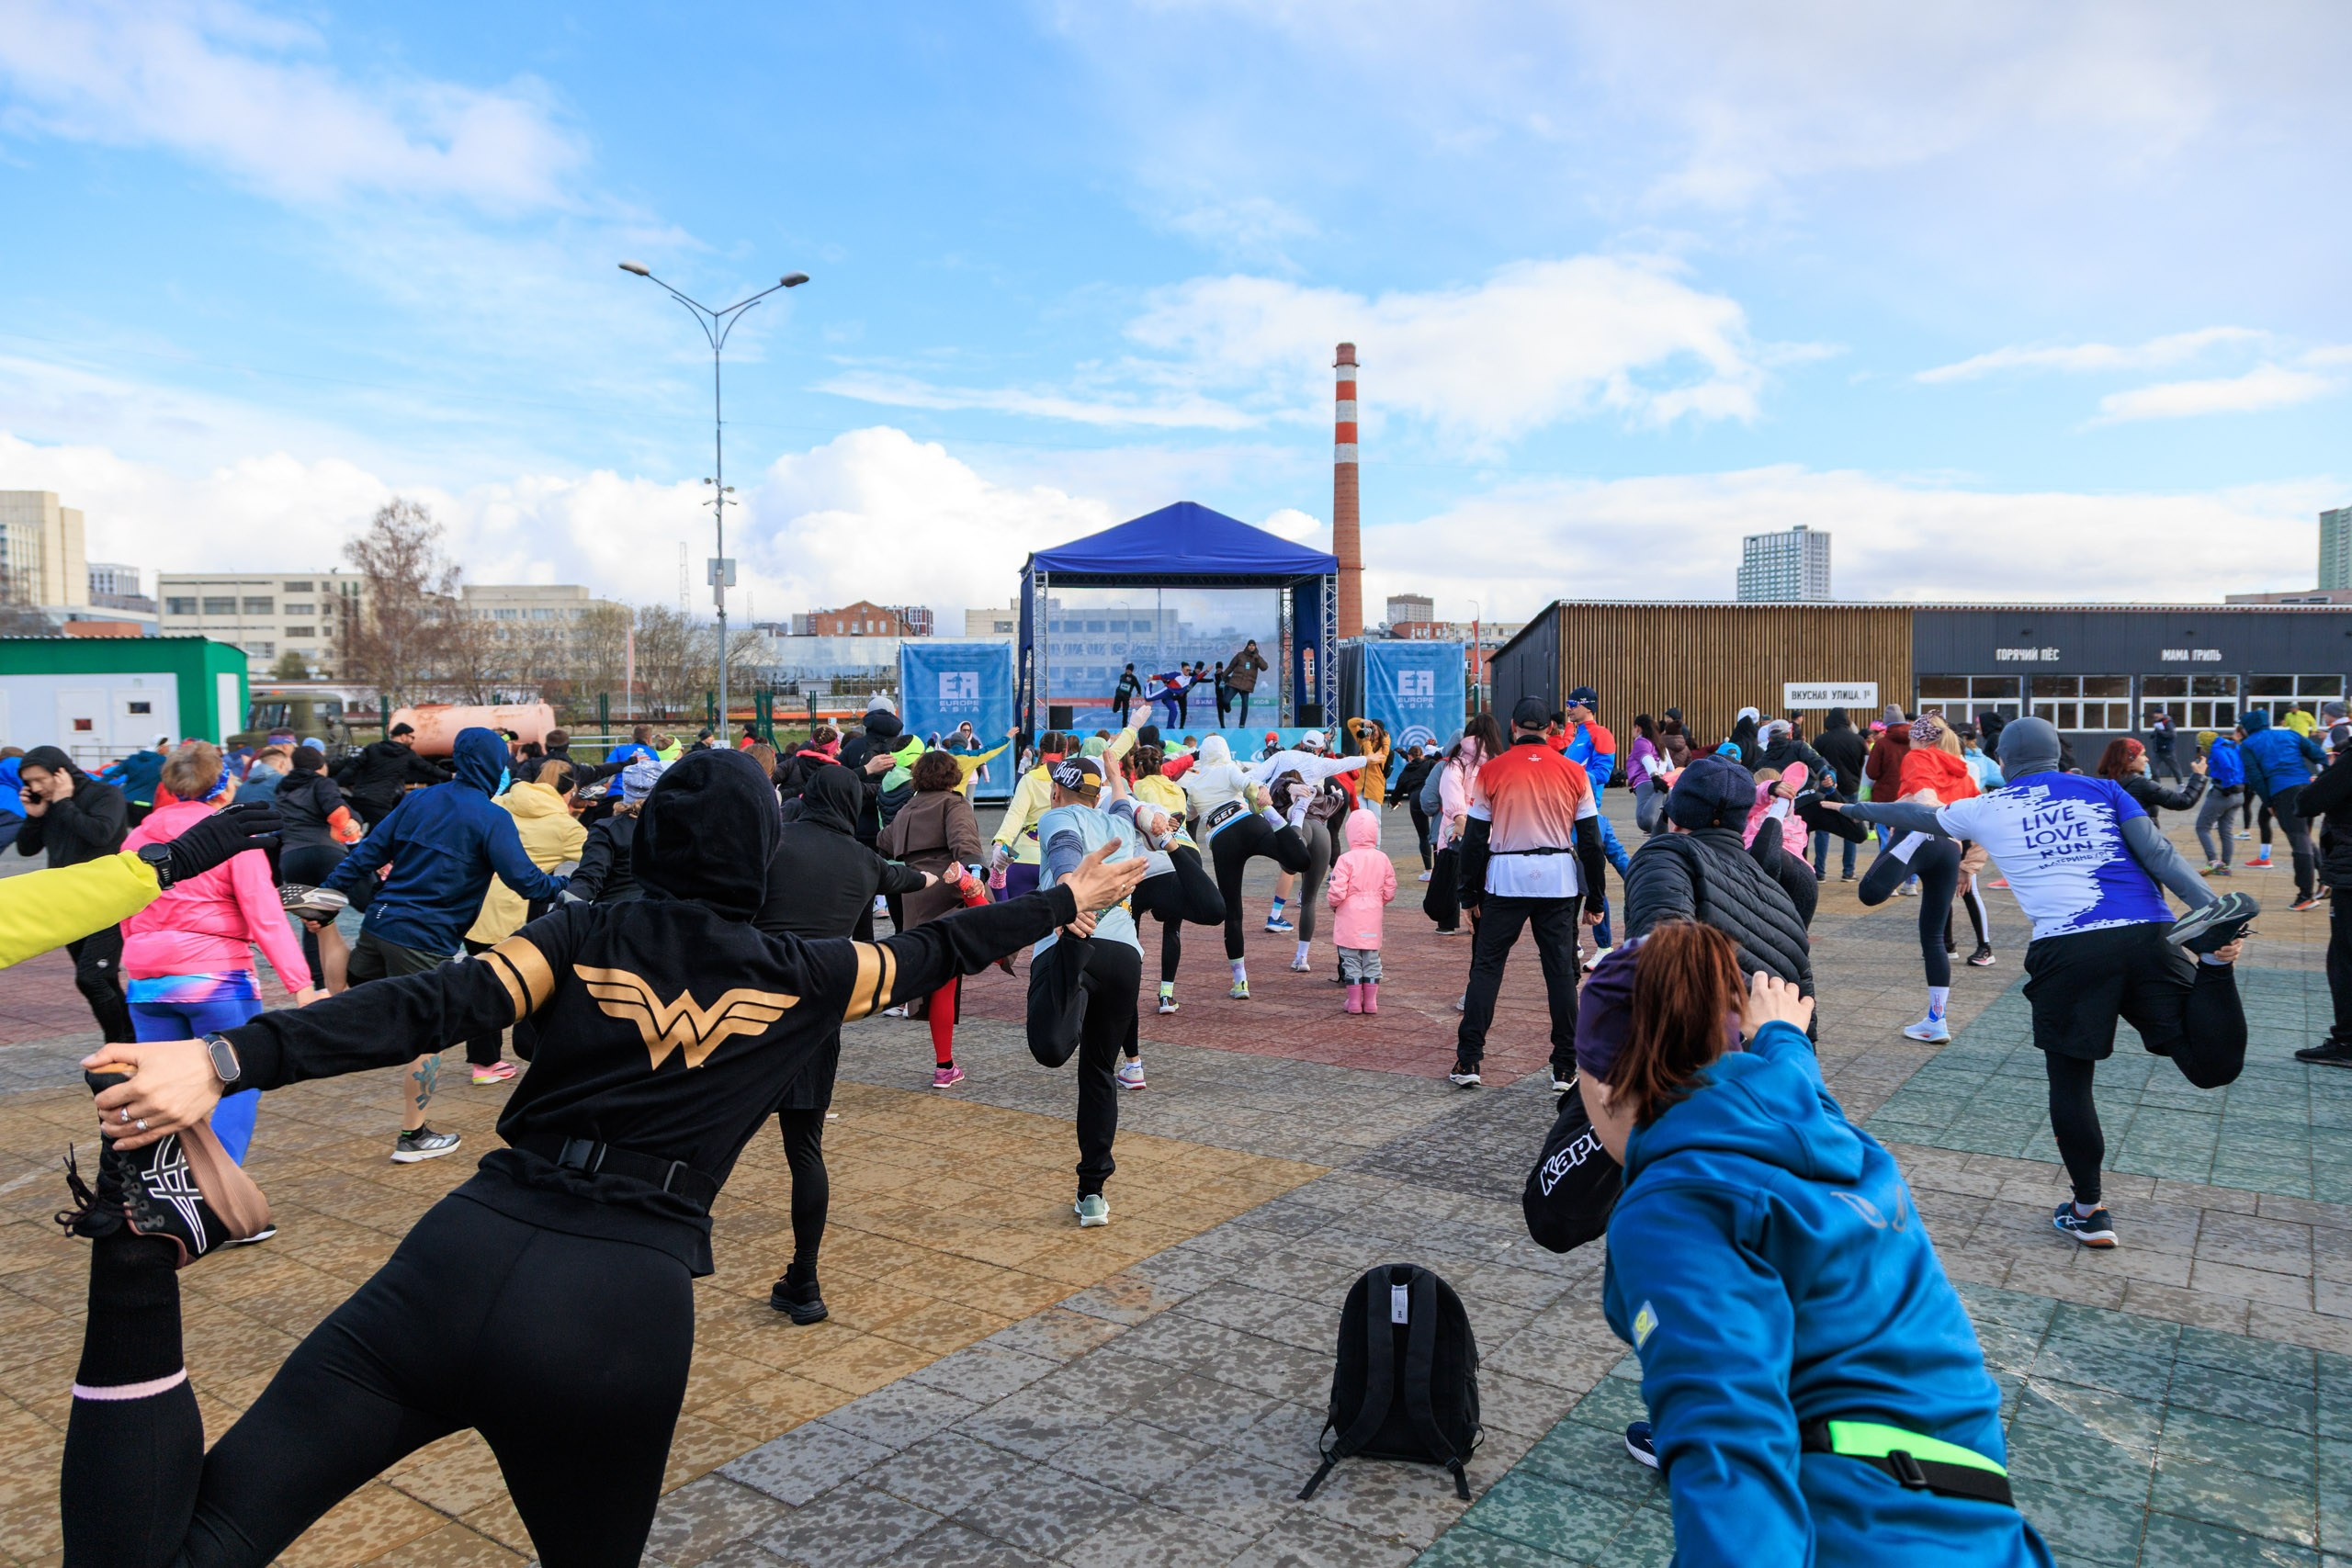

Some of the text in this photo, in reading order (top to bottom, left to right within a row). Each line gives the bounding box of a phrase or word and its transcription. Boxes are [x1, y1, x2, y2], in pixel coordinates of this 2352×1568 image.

[1996, 647, 2060, 661] ГОРЯЧИЙ ПЁС
[2162, 649, 2222, 661] МАМА ГРИЛЬ
[1792, 690, 1827, 700] ВКУСНАЯ
[1214, 807, 1235, 825] БЕГ
[2022, 806, 2075, 832] LIVE
[2025, 821, 2089, 850] LOVE
[2040, 840, 2093, 859] RUN
[1540, 1125, 1603, 1196] Kap
